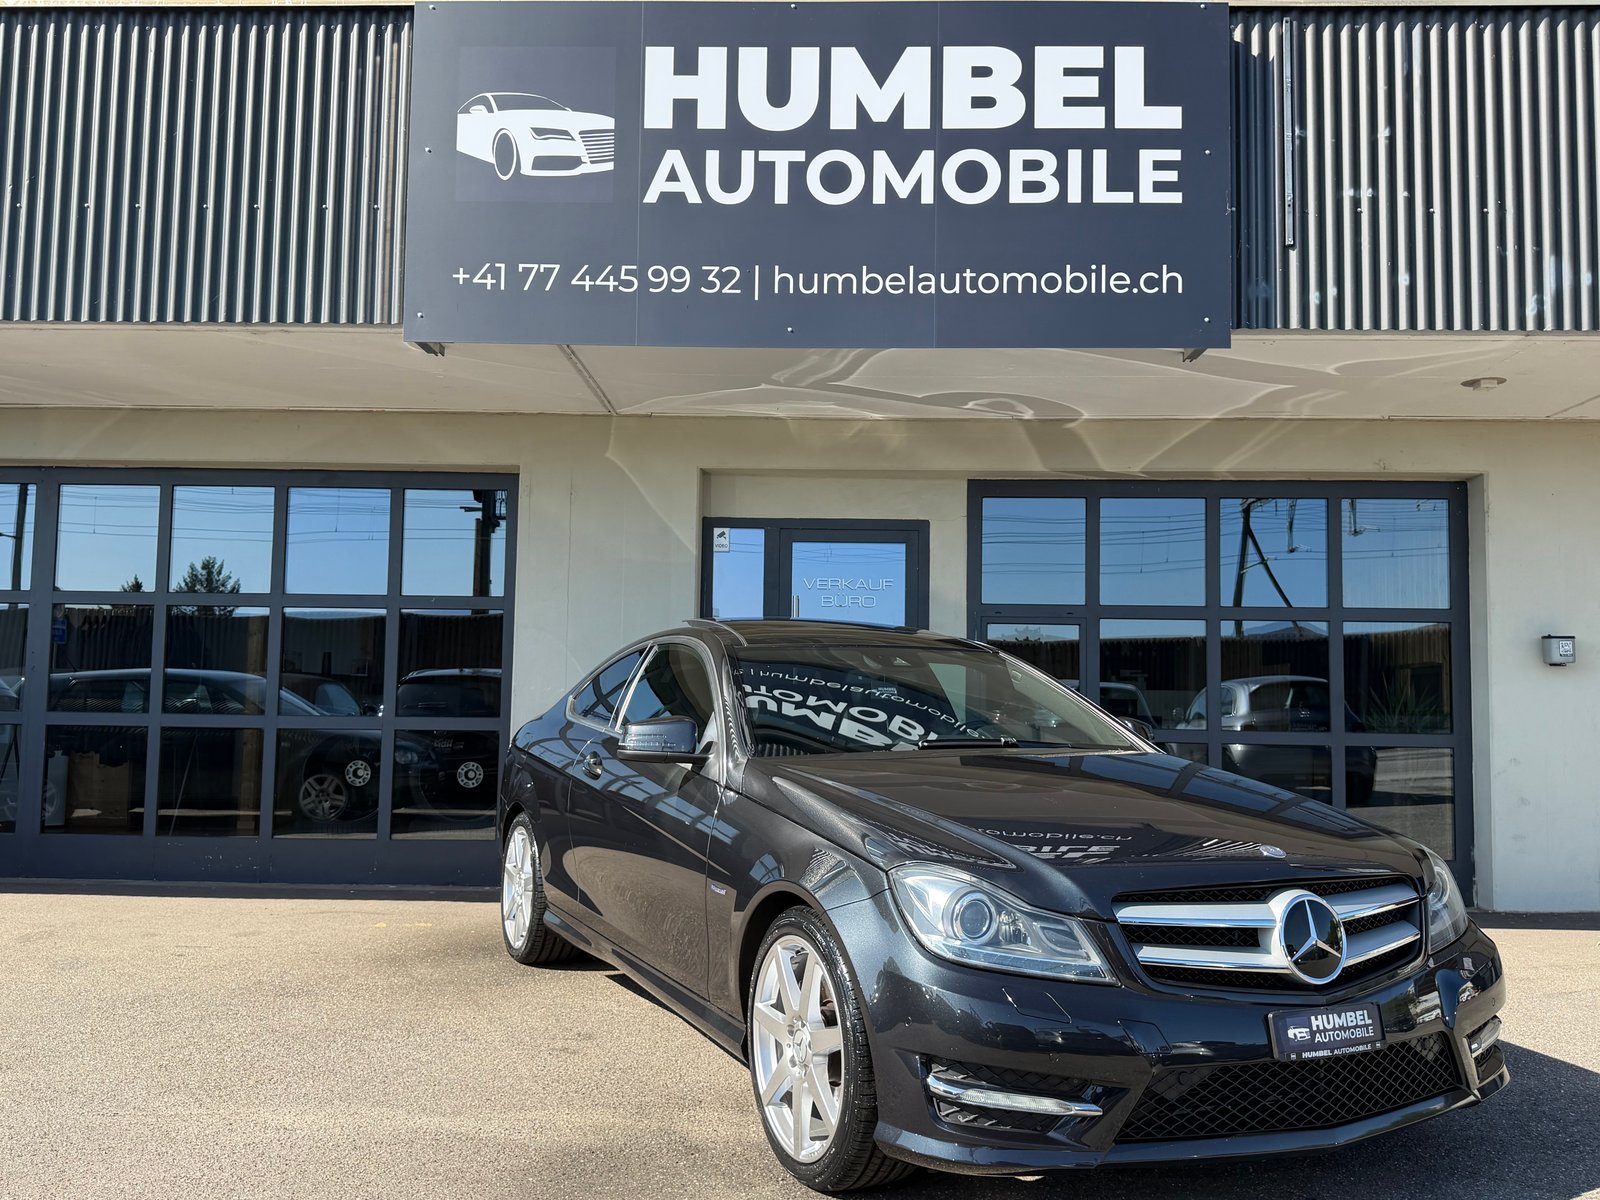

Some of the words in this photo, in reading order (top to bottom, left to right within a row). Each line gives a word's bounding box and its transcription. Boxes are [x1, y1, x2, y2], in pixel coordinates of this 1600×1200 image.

[643, 45, 1183, 132] HUMBEL
[642, 148, 1183, 206] AUTOMOBILE
[451, 263, 506, 291] +41
[518, 263, 561, 291] 77
[570, 264, 639, 293] 445
[647, 265, 691, 294] 99
[700, 265, 742, 294] 32
[773, 264, 1183, 296] humbelautomobile.ch
[803, 578, 894, 591] VERKAUF
[820, 593, 877, 608] BÜRO
[1310, 1010, 1373, 1031] HUMBEL
[1314, 1026, 1375, 1043] AUTOMOBILE
[1302, 1050, 1333, 1059] HUMBEL
[1333, 1043, 1372, 1055] AUTOMOBILE
